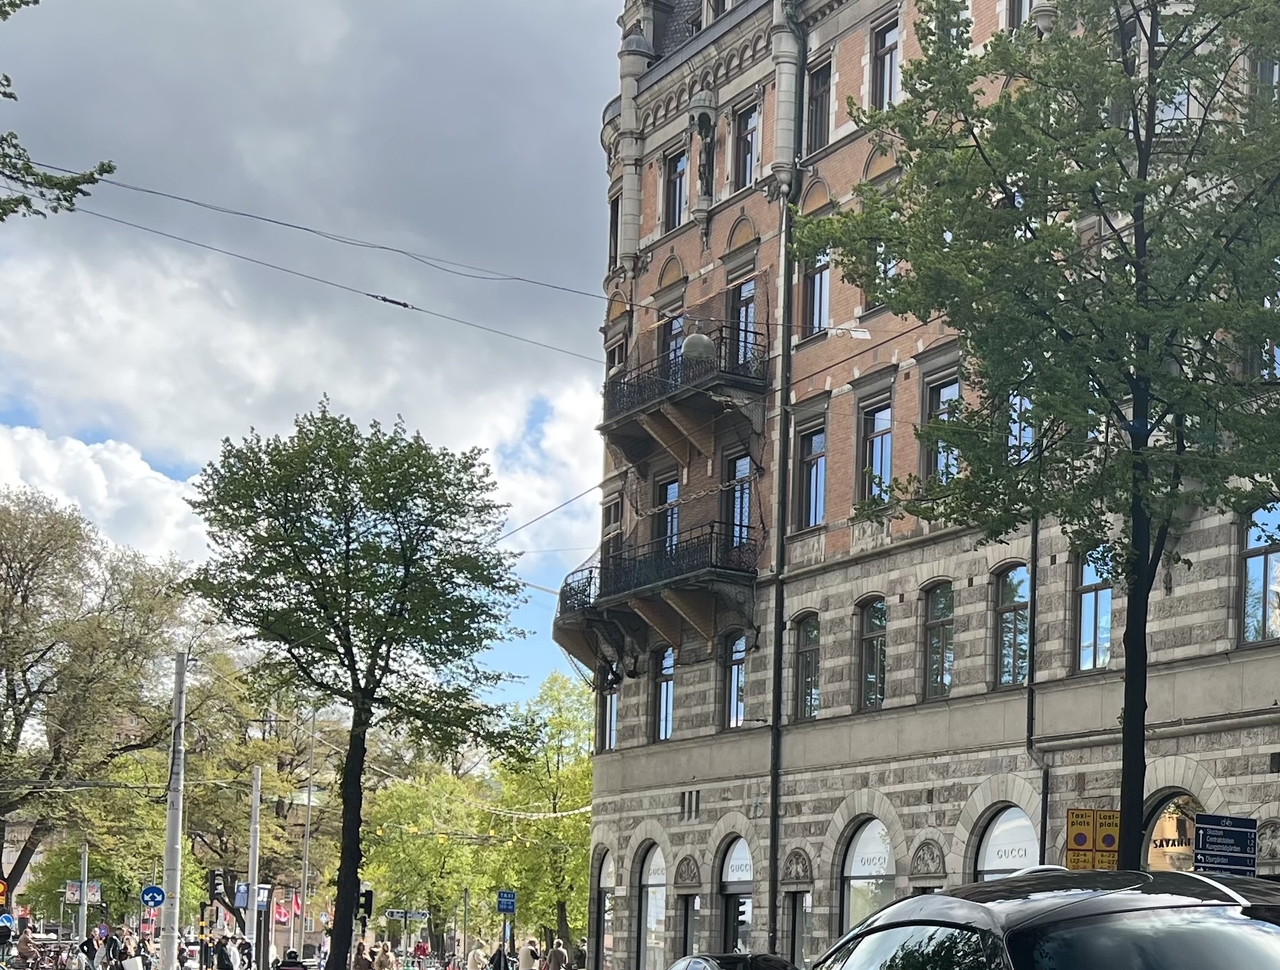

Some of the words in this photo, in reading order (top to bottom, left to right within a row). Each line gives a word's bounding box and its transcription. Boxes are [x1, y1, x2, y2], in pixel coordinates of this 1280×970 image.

[996, 848, 1027, 860] GUCCI
[860, 856, 887, 867] GUCCI
[648, 867, 666, 876] GUCC
